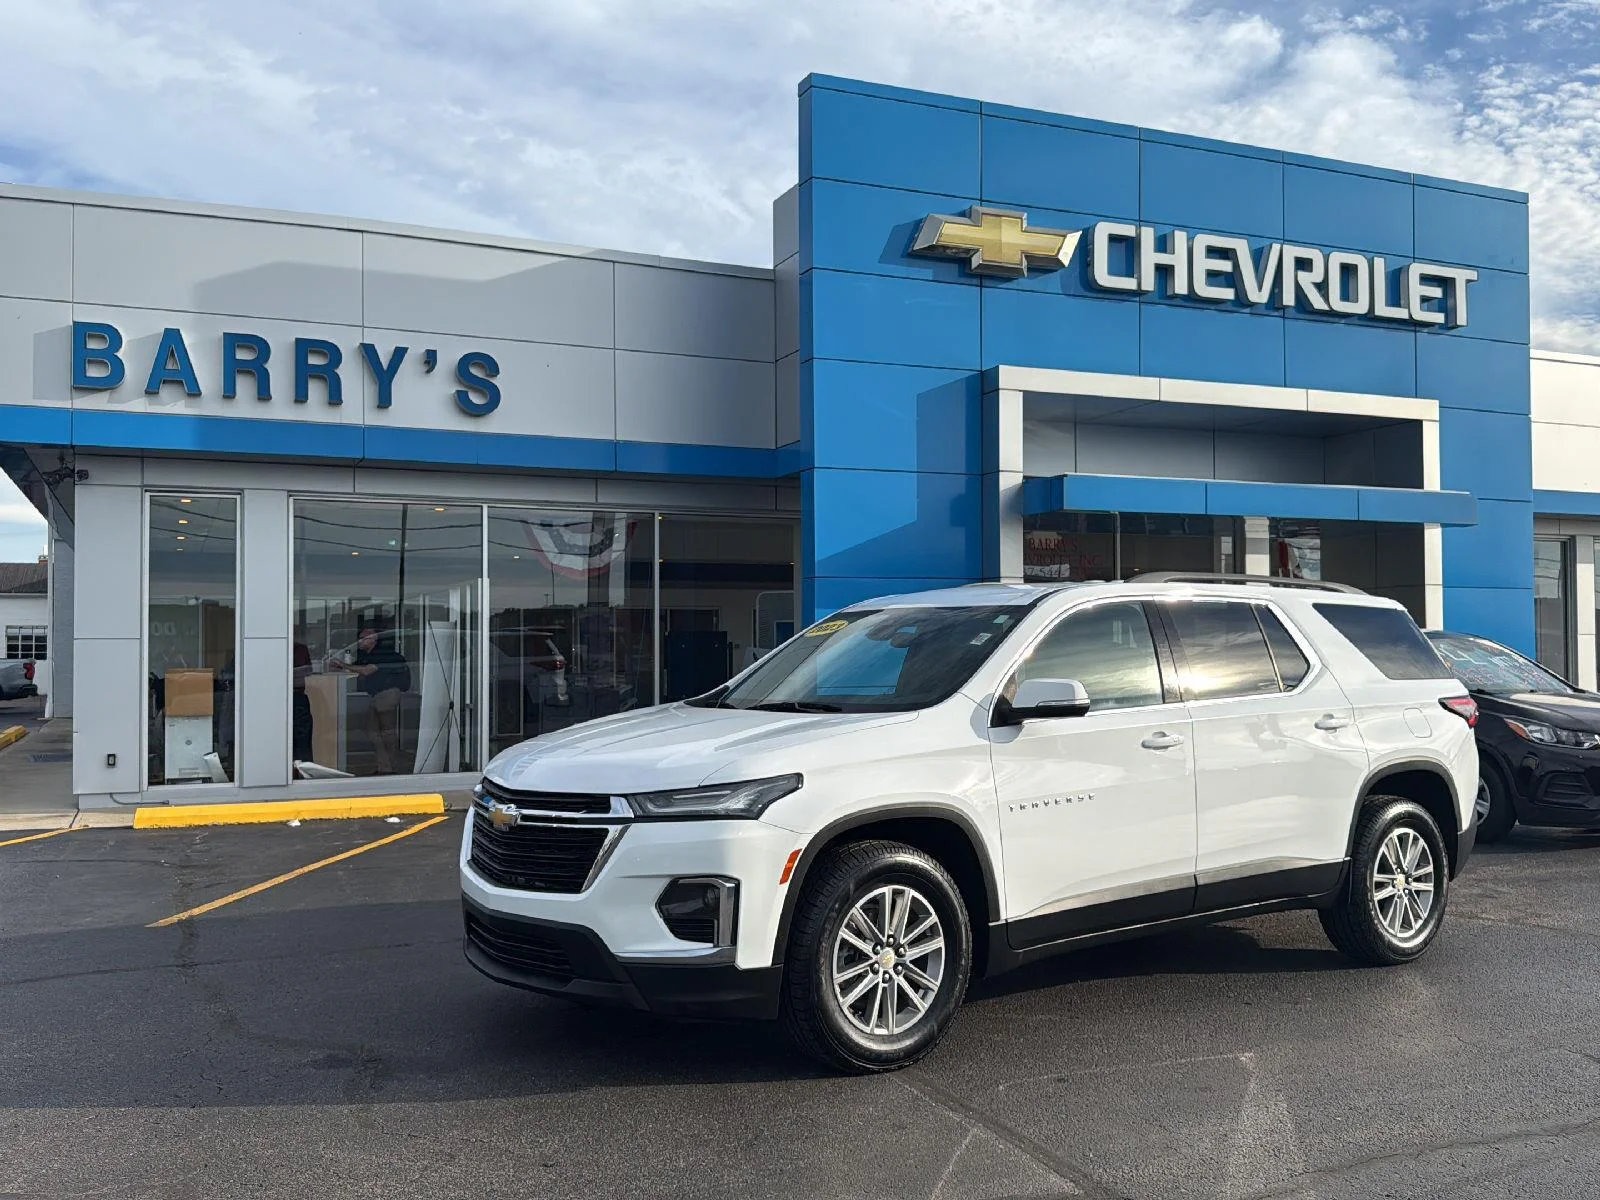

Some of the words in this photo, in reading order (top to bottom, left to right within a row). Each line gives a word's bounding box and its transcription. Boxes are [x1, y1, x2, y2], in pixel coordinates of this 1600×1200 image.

[1092, 221, 1478, 327] CHEVROLET
[72, 321, 501, 417] BARRY'S
[1008, 792, 1095, 812] TRAVERSE
